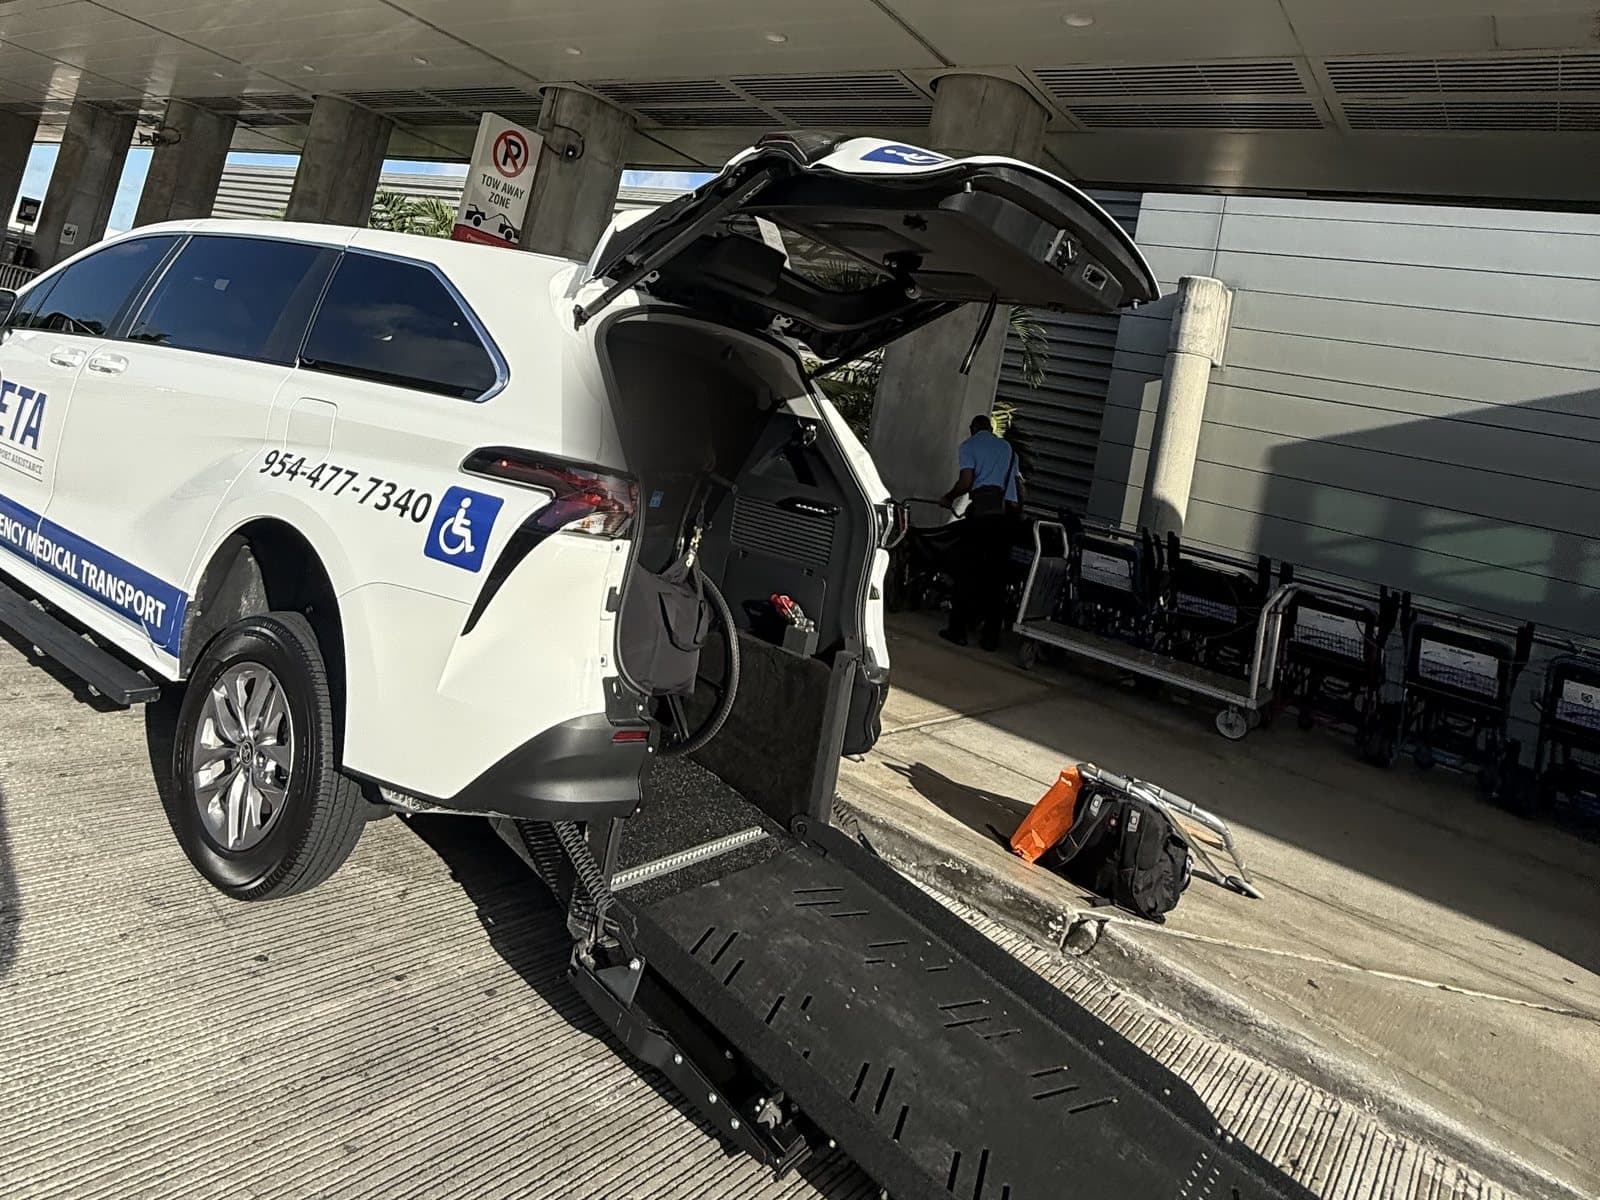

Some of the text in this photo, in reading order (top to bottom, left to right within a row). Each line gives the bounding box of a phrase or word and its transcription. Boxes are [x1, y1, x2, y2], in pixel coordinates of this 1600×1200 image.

[481, 173, 526, 200] TOW AWAY
[487, 191, 512, 209] ZONE
[259, 449, 433, 523] 954-477-7340
[25, 529, 79, 580] MEDICAL
[80, 558, 167, 629] TRANSPORT
